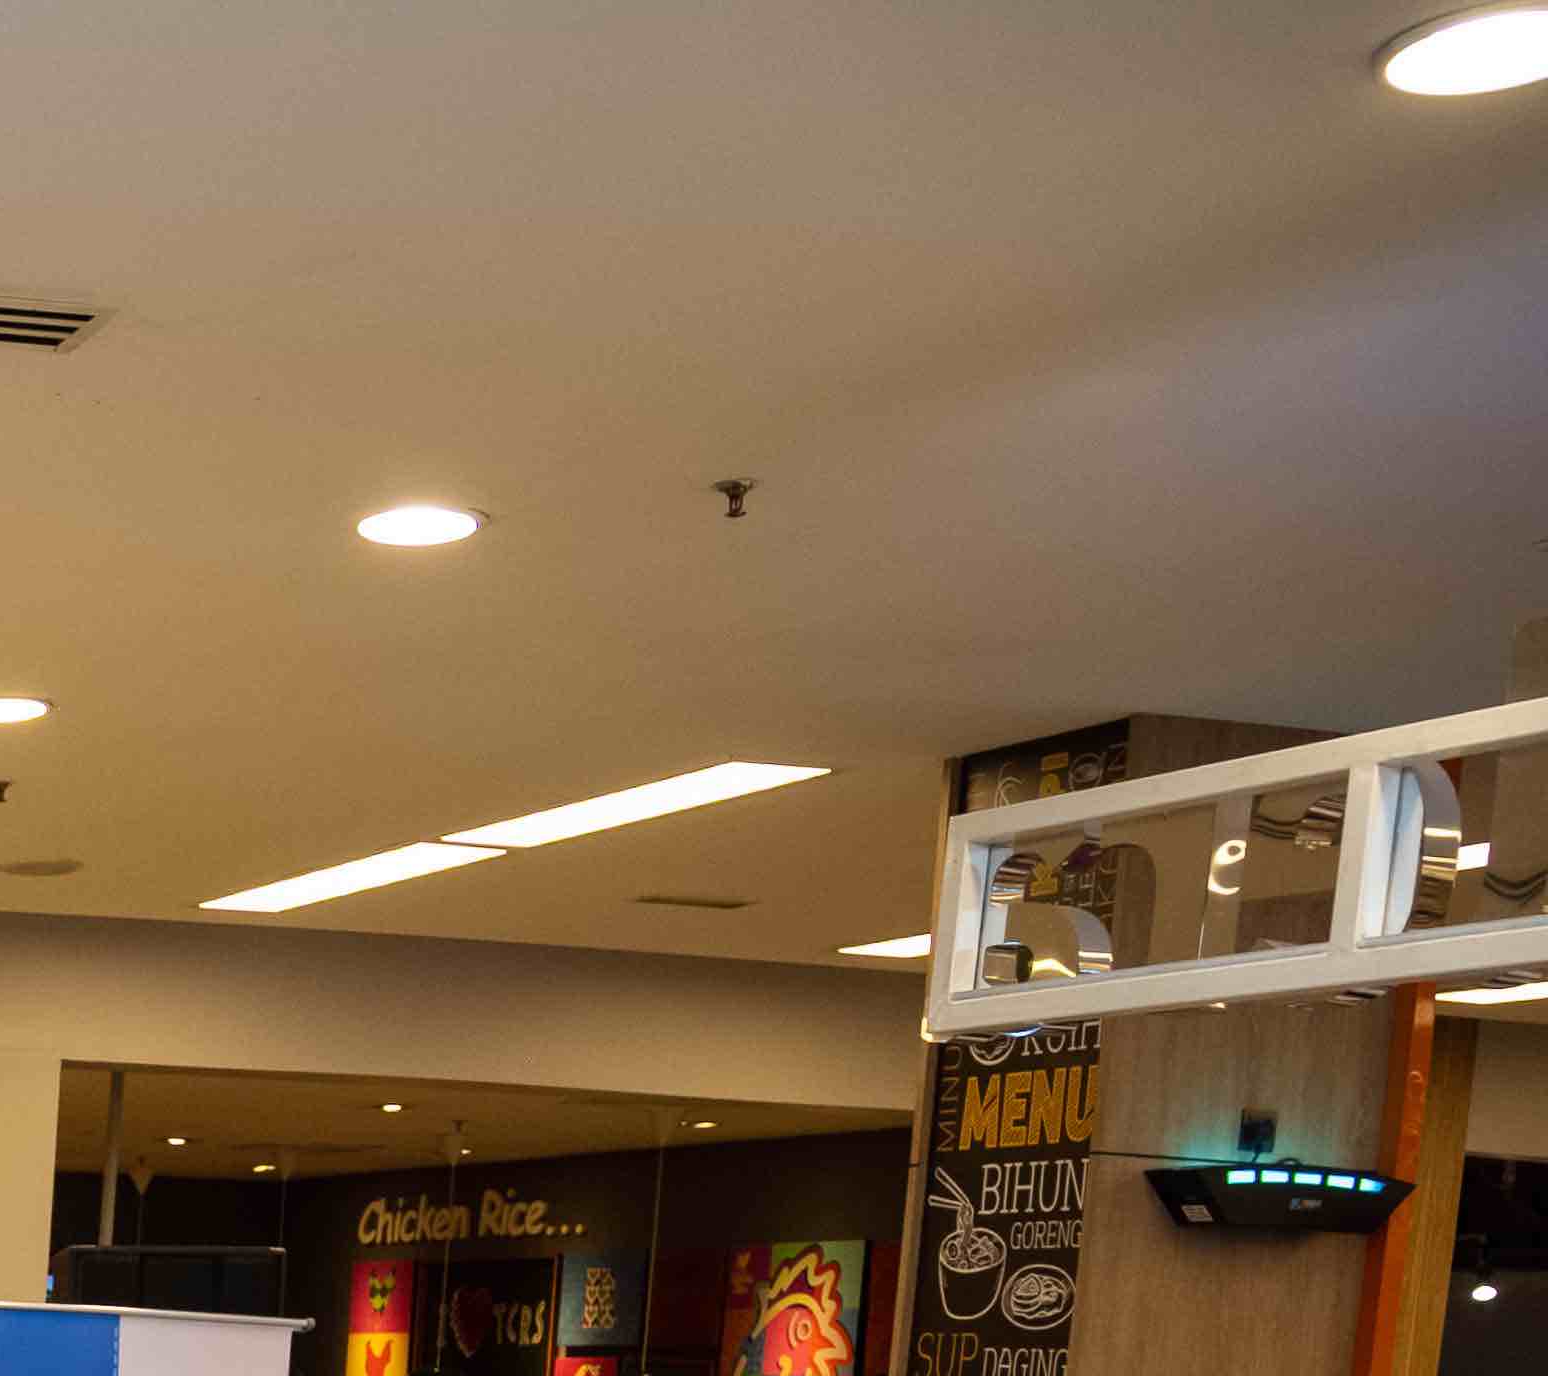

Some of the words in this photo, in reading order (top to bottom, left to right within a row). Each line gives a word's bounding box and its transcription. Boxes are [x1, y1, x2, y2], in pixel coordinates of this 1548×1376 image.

[938, 1046, 963, 1151] MINU
[959, 1065, 1100, 1151] MENU
[978, 1158, 1090, 1215] BIHUN
[357, 1194, 470, 1247] Chicken
[1010, 1220, 1084, 1250] GORENG
